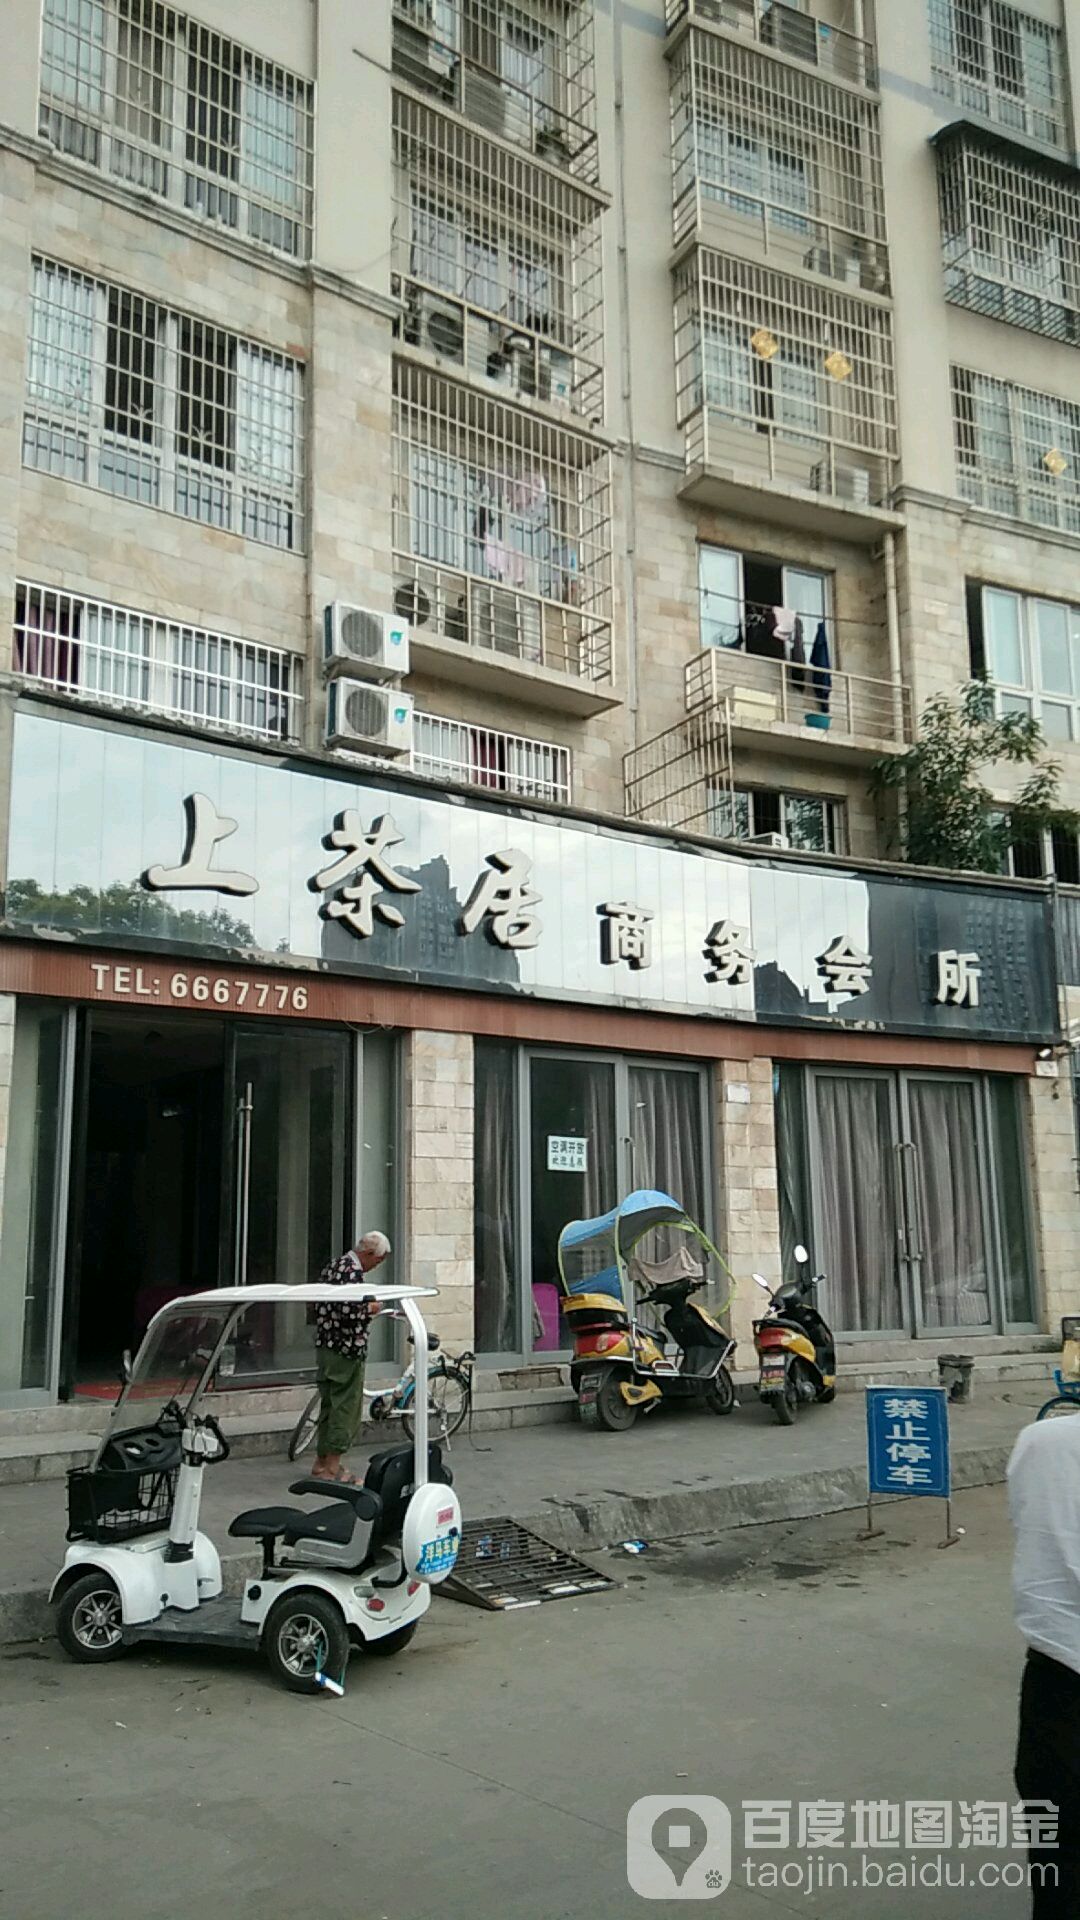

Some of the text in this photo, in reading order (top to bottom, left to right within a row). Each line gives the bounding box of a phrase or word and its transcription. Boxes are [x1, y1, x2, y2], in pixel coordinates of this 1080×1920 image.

[91, 963, 308, 1010] TEL: 6667776
[883, 1398, 933, 1486] 禁止停车
